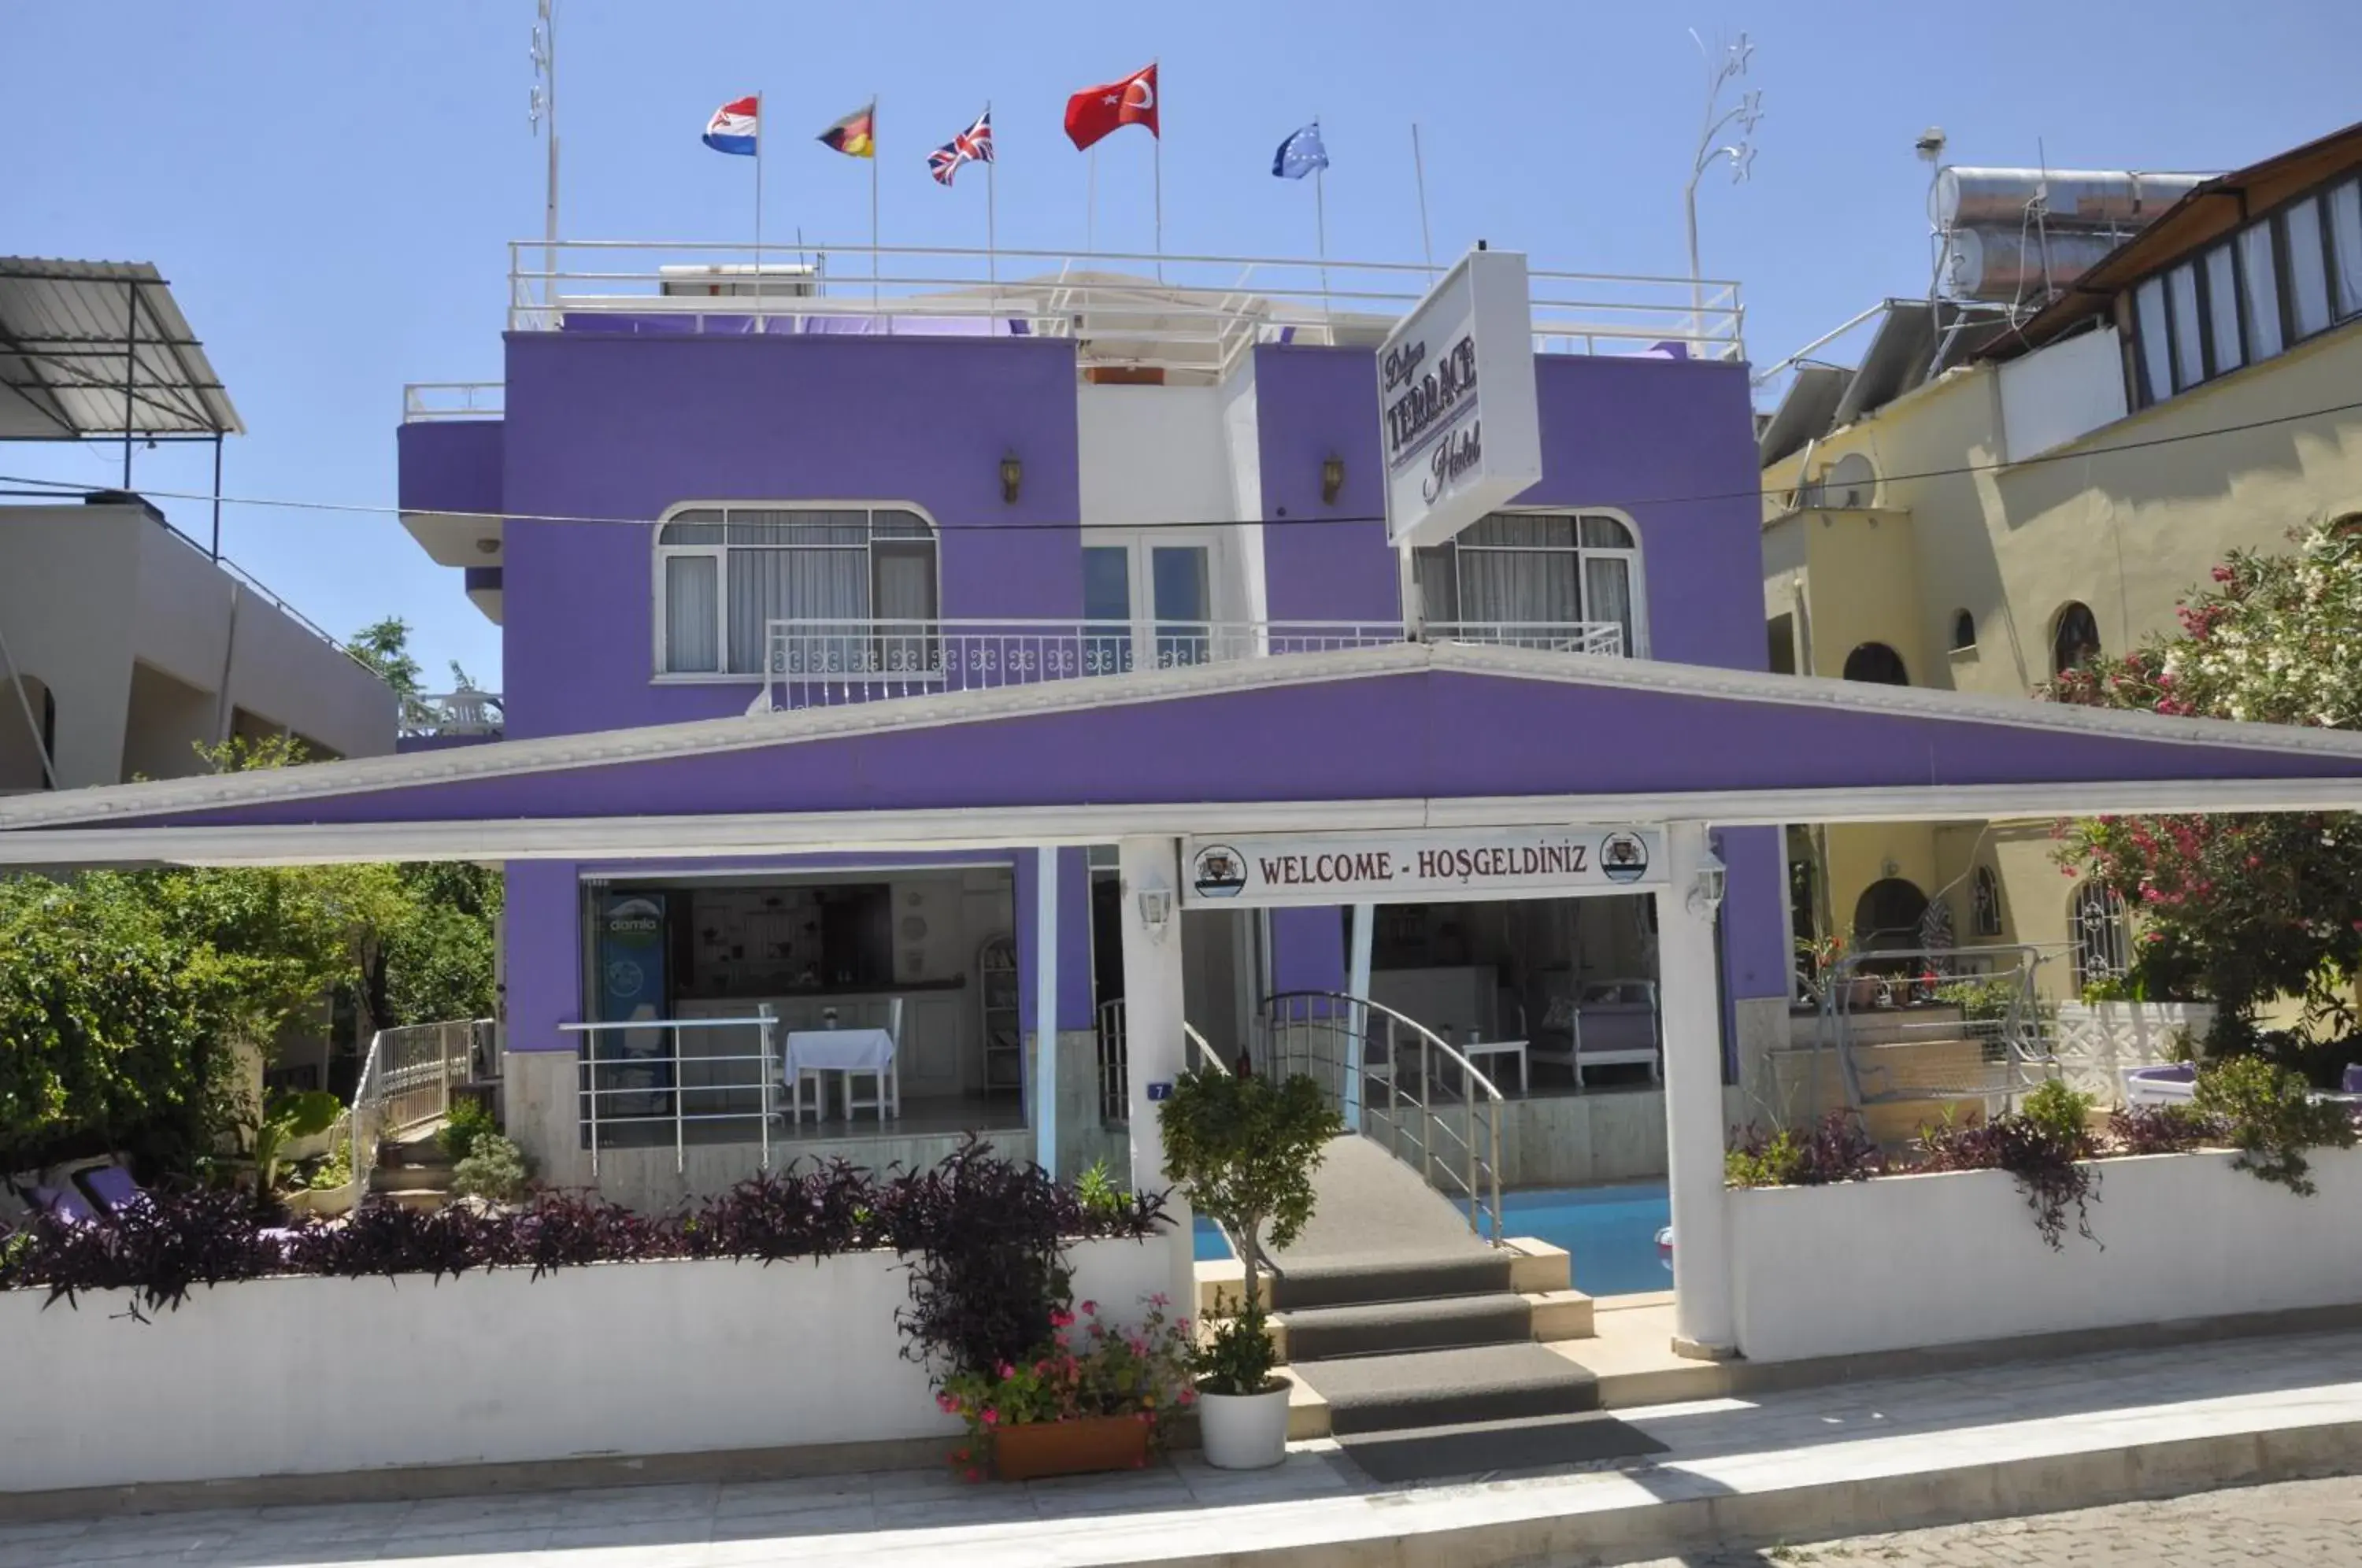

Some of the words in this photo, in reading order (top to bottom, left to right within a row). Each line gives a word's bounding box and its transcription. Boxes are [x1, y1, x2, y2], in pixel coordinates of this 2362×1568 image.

[1387, 335, 1477, 452] TERRACE
[1423, 420, 1480, 505] Hotel
[1259, 852, 1394, 885] WELCOME
[1418, 838, 1588, 884] HOŞGELDİNİZ
[610, 917, 656, 931] damla
[1156, 1085, 1163, 1099] 7
